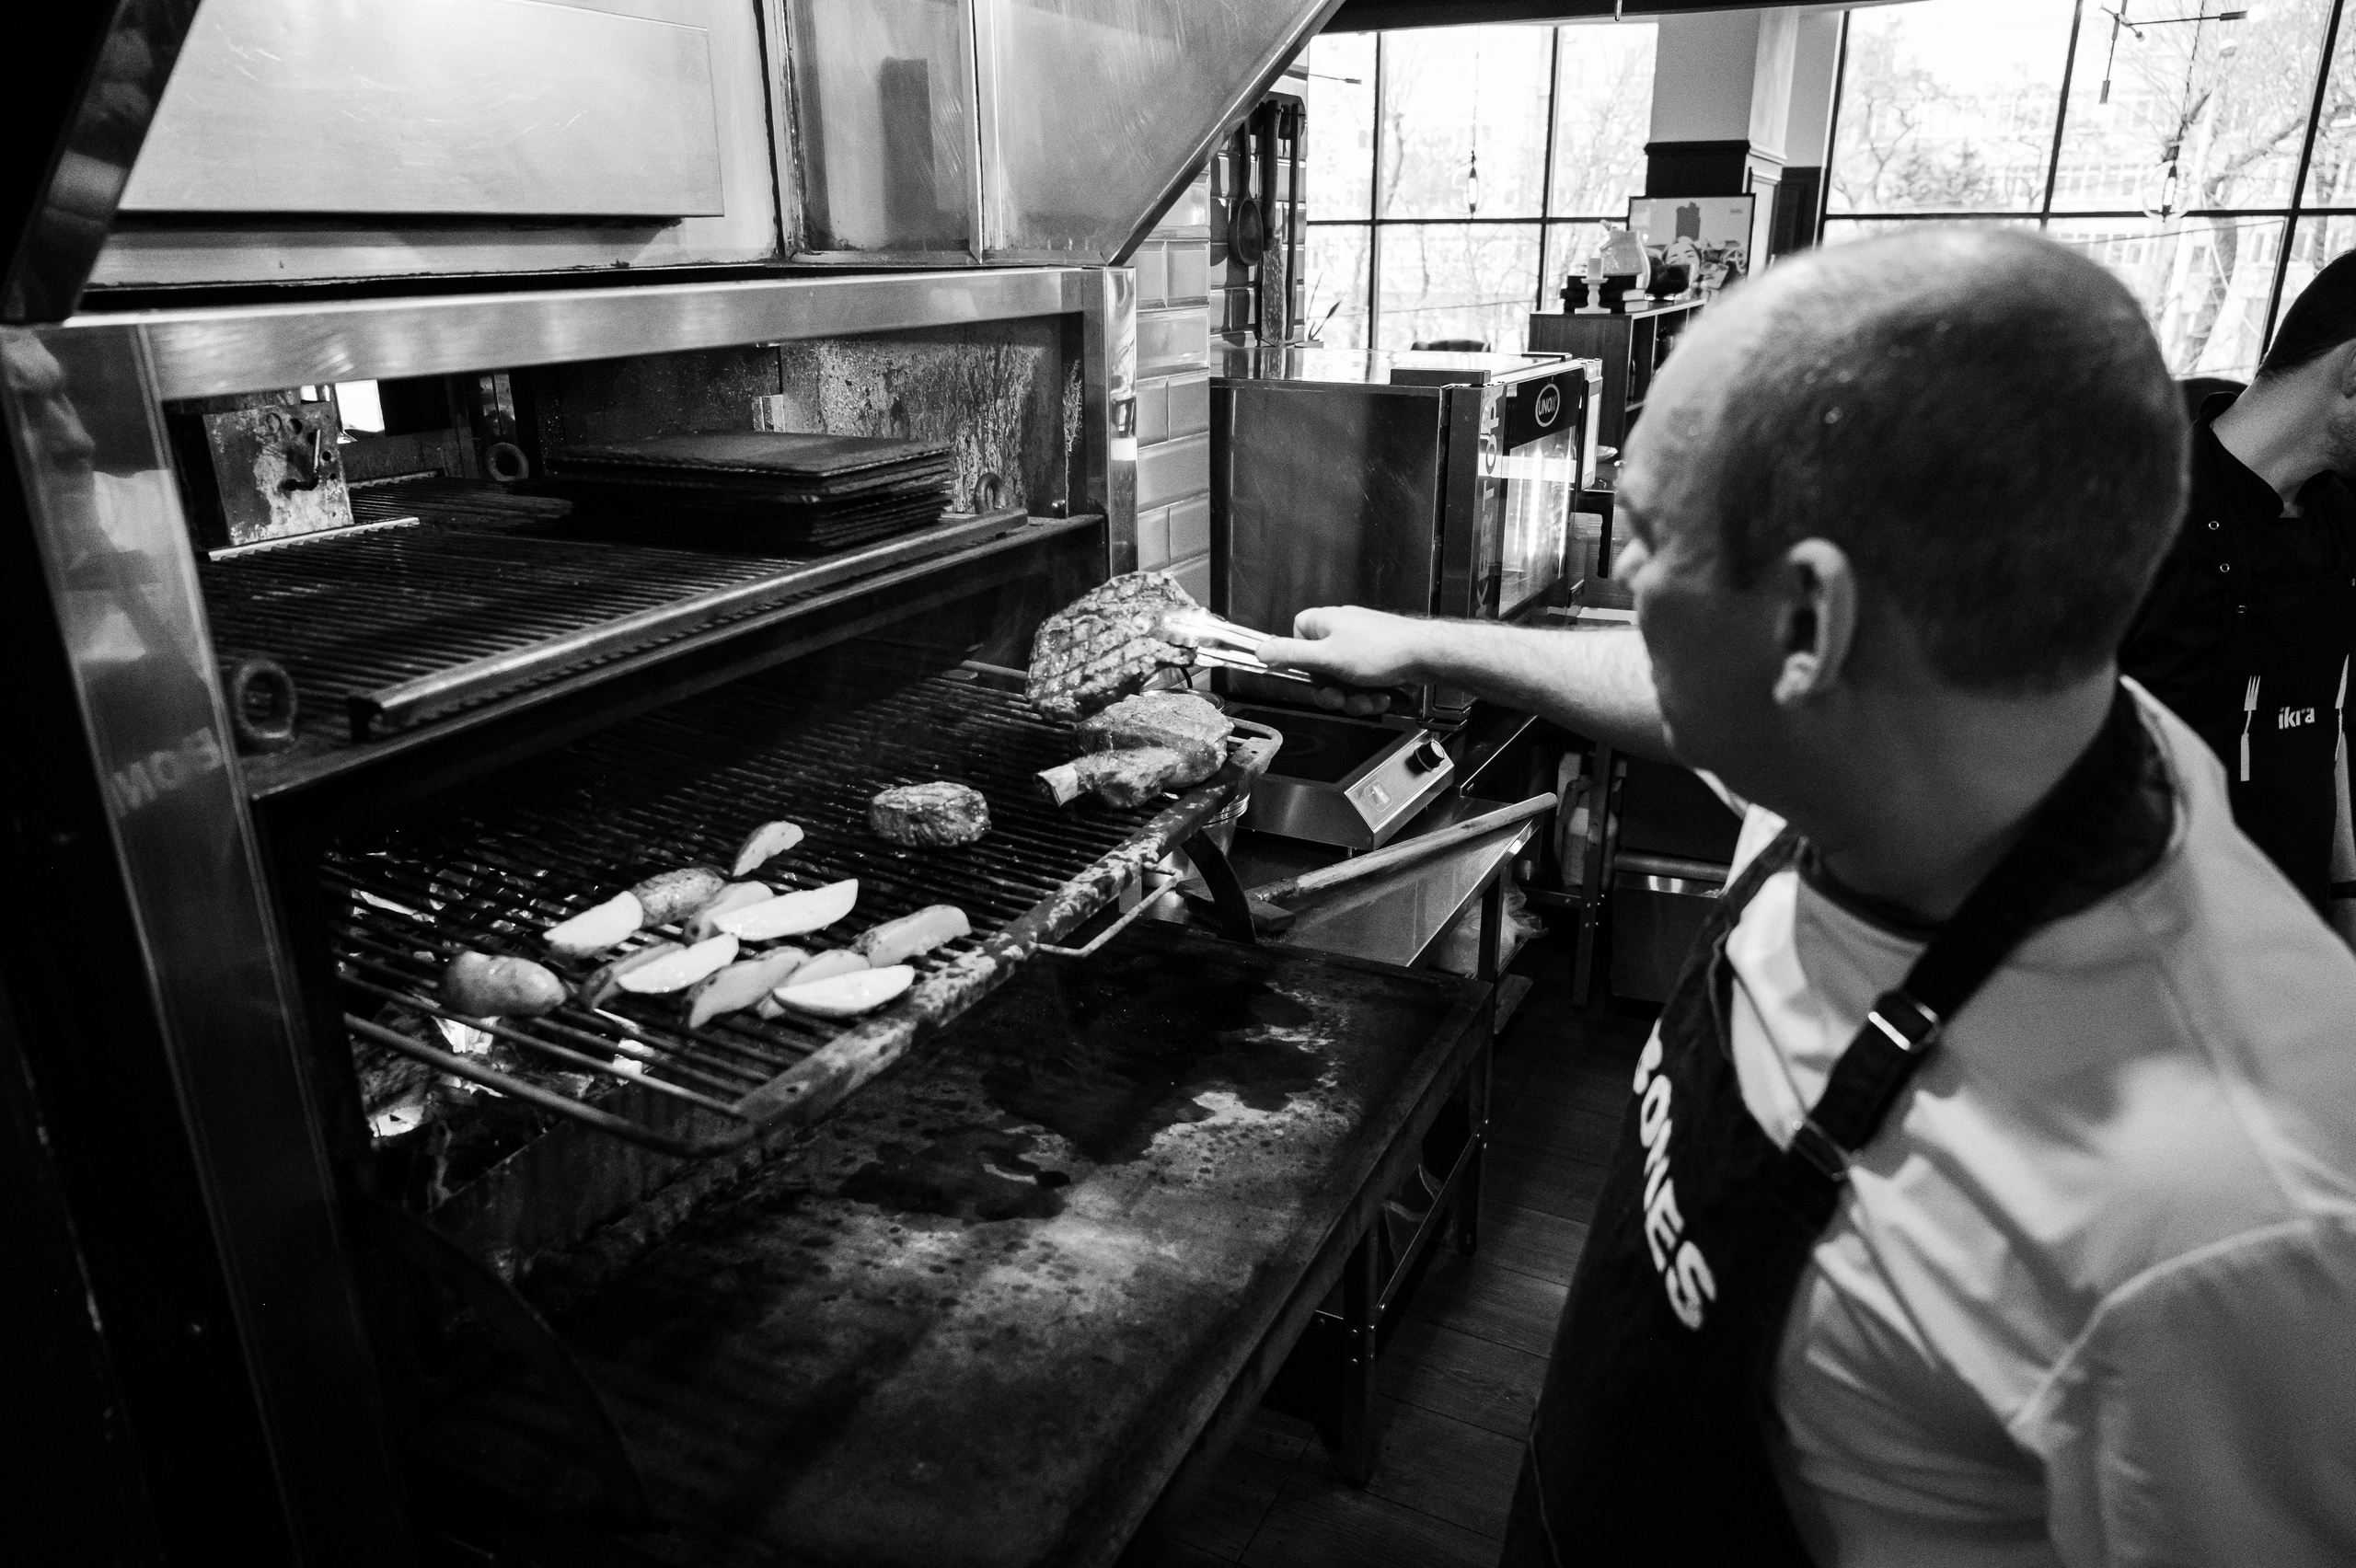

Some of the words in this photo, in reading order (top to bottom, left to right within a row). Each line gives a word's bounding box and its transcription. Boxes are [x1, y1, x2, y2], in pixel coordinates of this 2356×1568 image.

[1538, 395, 1557, 416] UNOX
[1474, 397, 1499, 619] KERTOP
[2278, 706, 2316, 730] ikra
